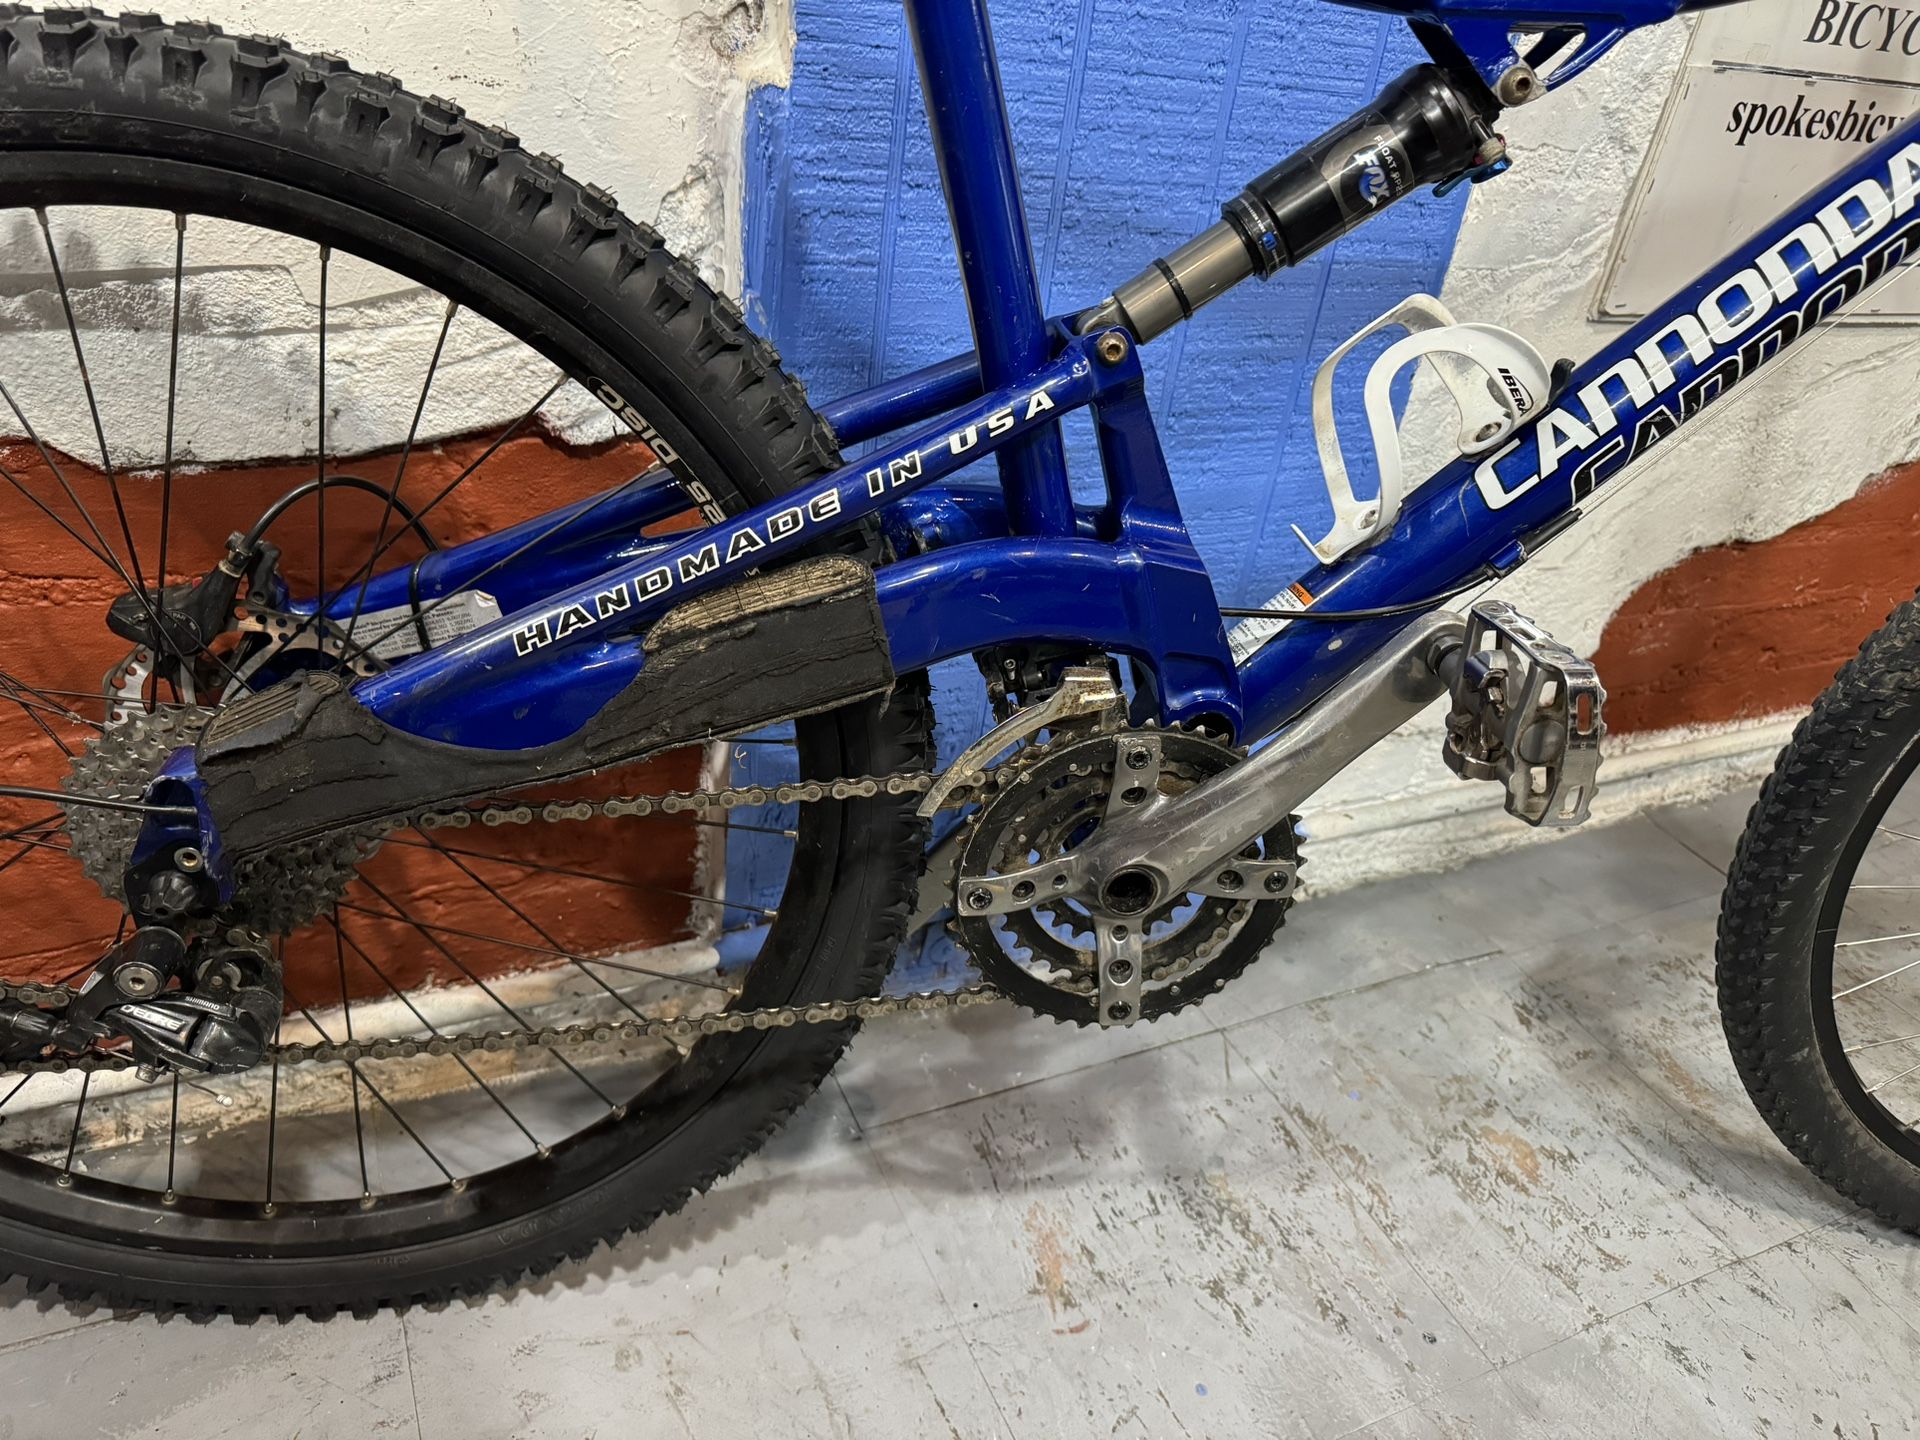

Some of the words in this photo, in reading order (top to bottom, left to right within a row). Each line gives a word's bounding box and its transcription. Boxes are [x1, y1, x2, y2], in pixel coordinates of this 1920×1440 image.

[1374, 134, 1397, 170] FLOAT
[596, 384, 679, 464] DISC
[513, 488, 841, 657] HANDMADE
[866, 450, 924, 498] IN
[948, 390, 1055, 456] USA
[120, 1004, 185, 1031] DEORE
[185, 995, 220, 1011] SHIMANO
